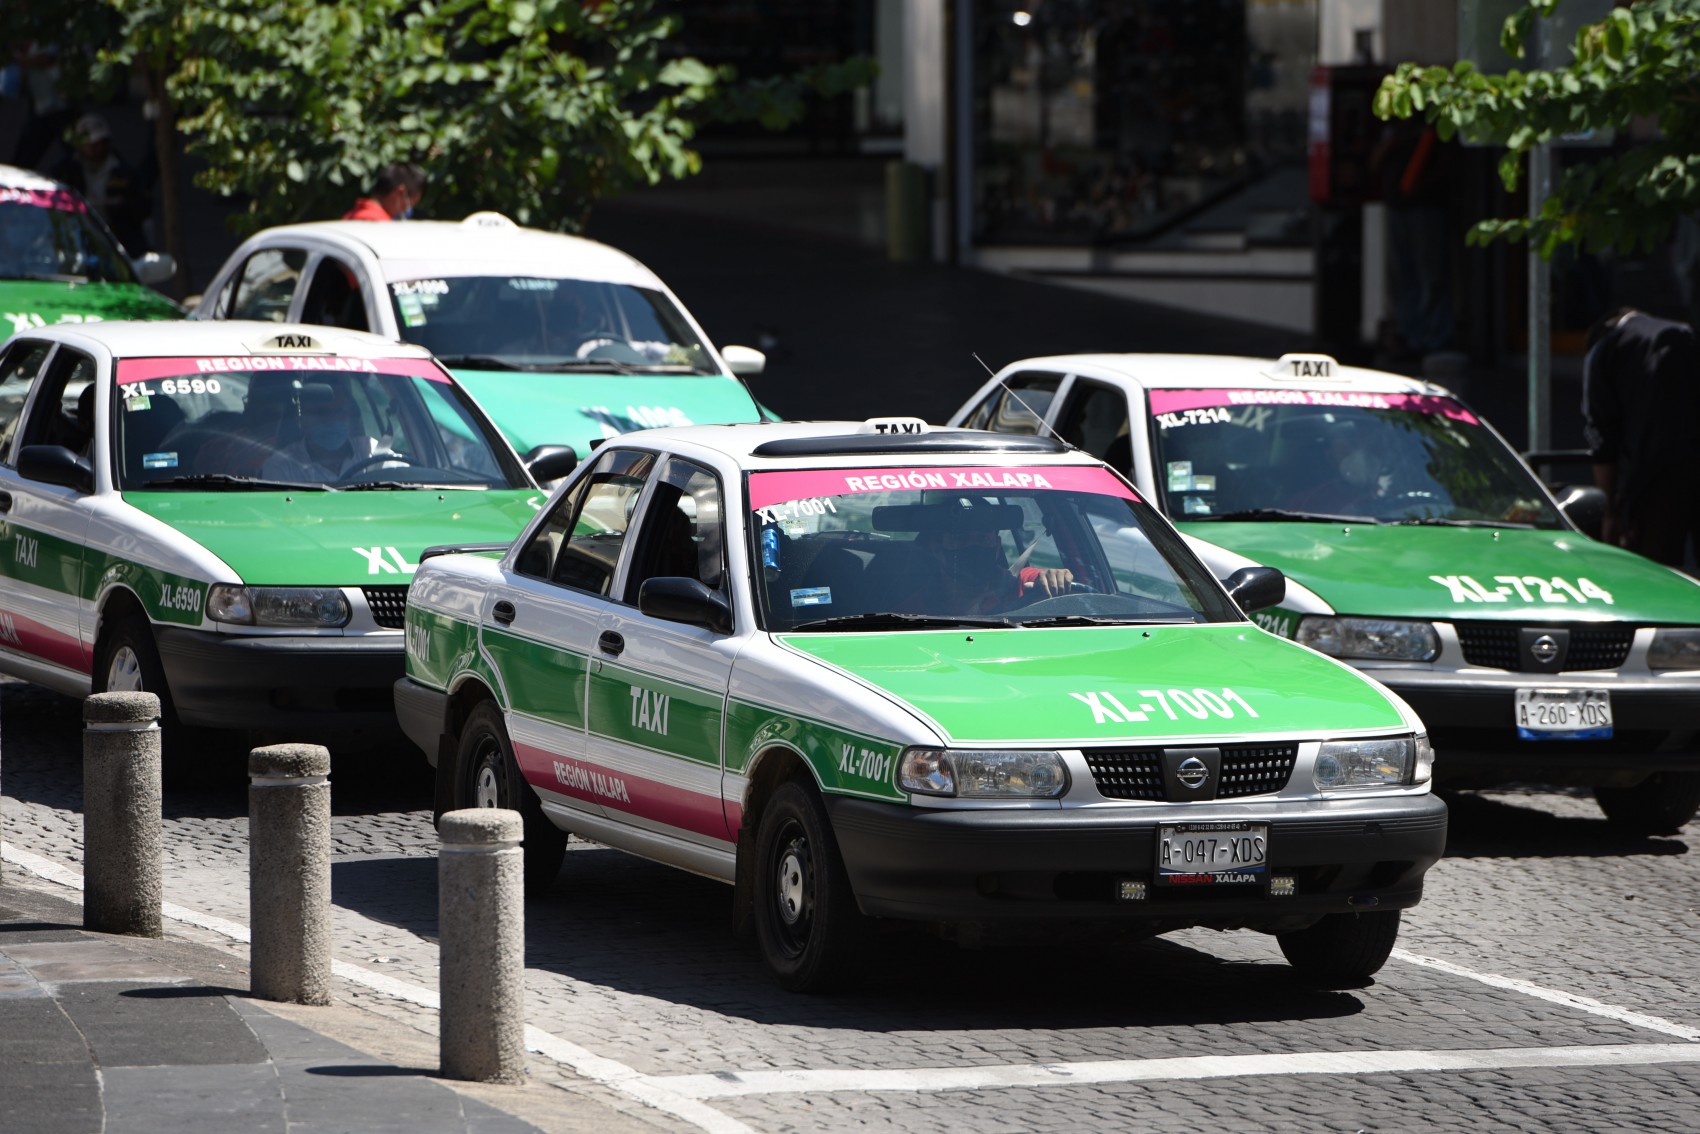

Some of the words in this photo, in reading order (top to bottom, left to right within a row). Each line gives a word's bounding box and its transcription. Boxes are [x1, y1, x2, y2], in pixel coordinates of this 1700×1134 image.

[276, 335, 312, 348] TAXI
[289, 357, 378, 372] XALAPA
[1291, 360, 1330, 377] TAXI
[121, 384, 155, 398] XL
[162, 379, 221, 394] 6590
[1308, 392, 1391, 409] XALAPA
[875, 423, 922, 435] TAXI
[1156, 408, 1232, 429] XL-7214
[844, 471, 947, 492] REGIÓN
[949, 472, 1053, 489] XALAPA
[755, 497, 837, 526] XL-7001
[15, 534, 39, 568] TAXI
[158, 583, 201, 613] XL-6590
[1428, 575, 1614, 605] XL-7214
[1246, 613, 1290, 638] 7214
[630, 685, 670, 736] TAXI
[1068, 687, 1260, 724] XL-7001
[1520, 704, 1608, 726] A-260-XDS
[839, 743, 892, 784] XL-7001
[553, 761, 592, 793] REGIÓN
[589, 770, 631, 804] XALAPA
[1162, 836, 1265, 865] A-047-XDS
[1169, 874, 1214, 884] NISSAN
[1215, 873, 1256, 883] XALAPA
